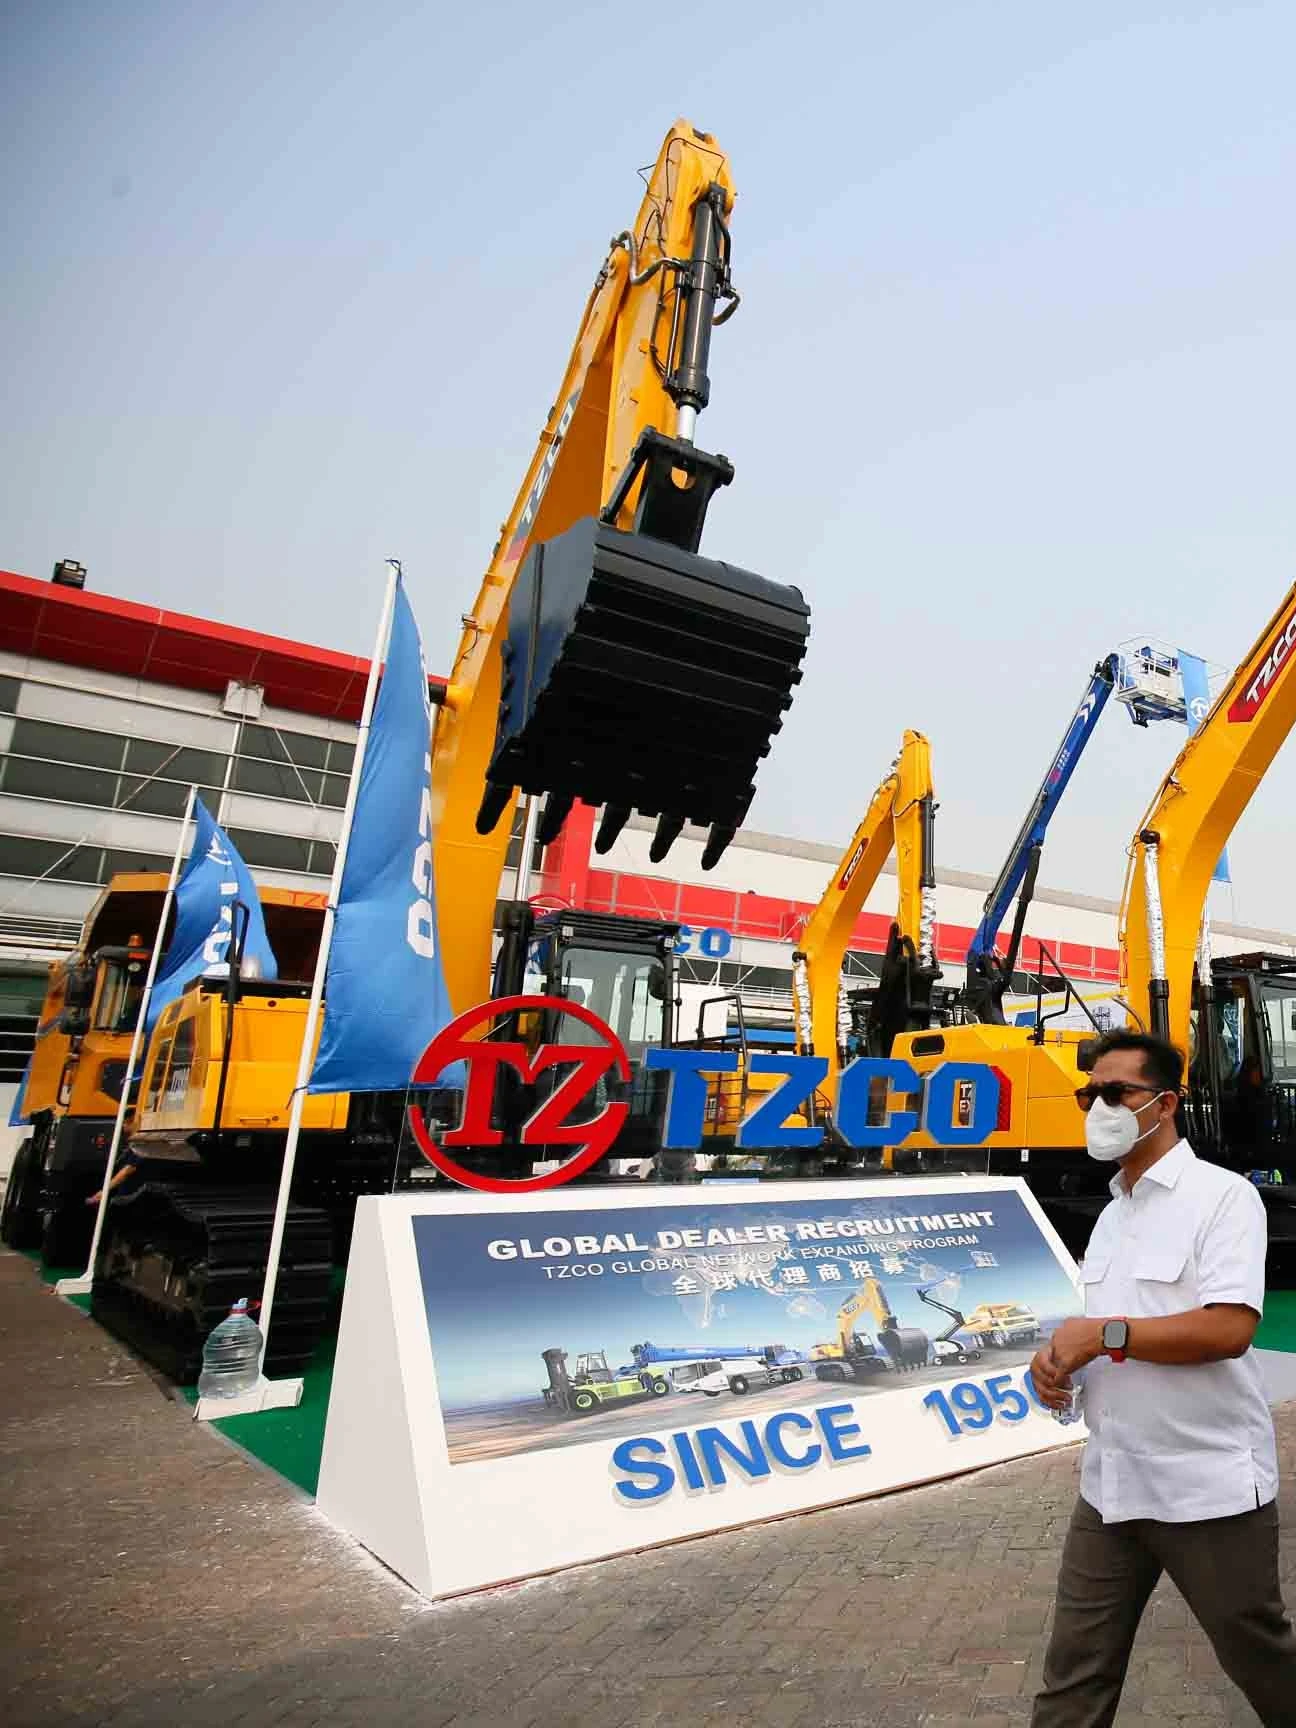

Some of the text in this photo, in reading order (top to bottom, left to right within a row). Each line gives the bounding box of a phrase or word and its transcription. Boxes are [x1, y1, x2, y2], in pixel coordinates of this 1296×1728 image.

[640, 1047, 1000, 1148] TZCO
[487, 1211, 997, 1261] GLOBAL DEALER RECRUITMENT
[541, 1233, 979, 1280] TZCO GLOBAL NETWORK EXPANDING PROGRAM
[671, 1256, 905, 1296] 全球代理商招募
[612, 1403, 872, 1500] SINCE
